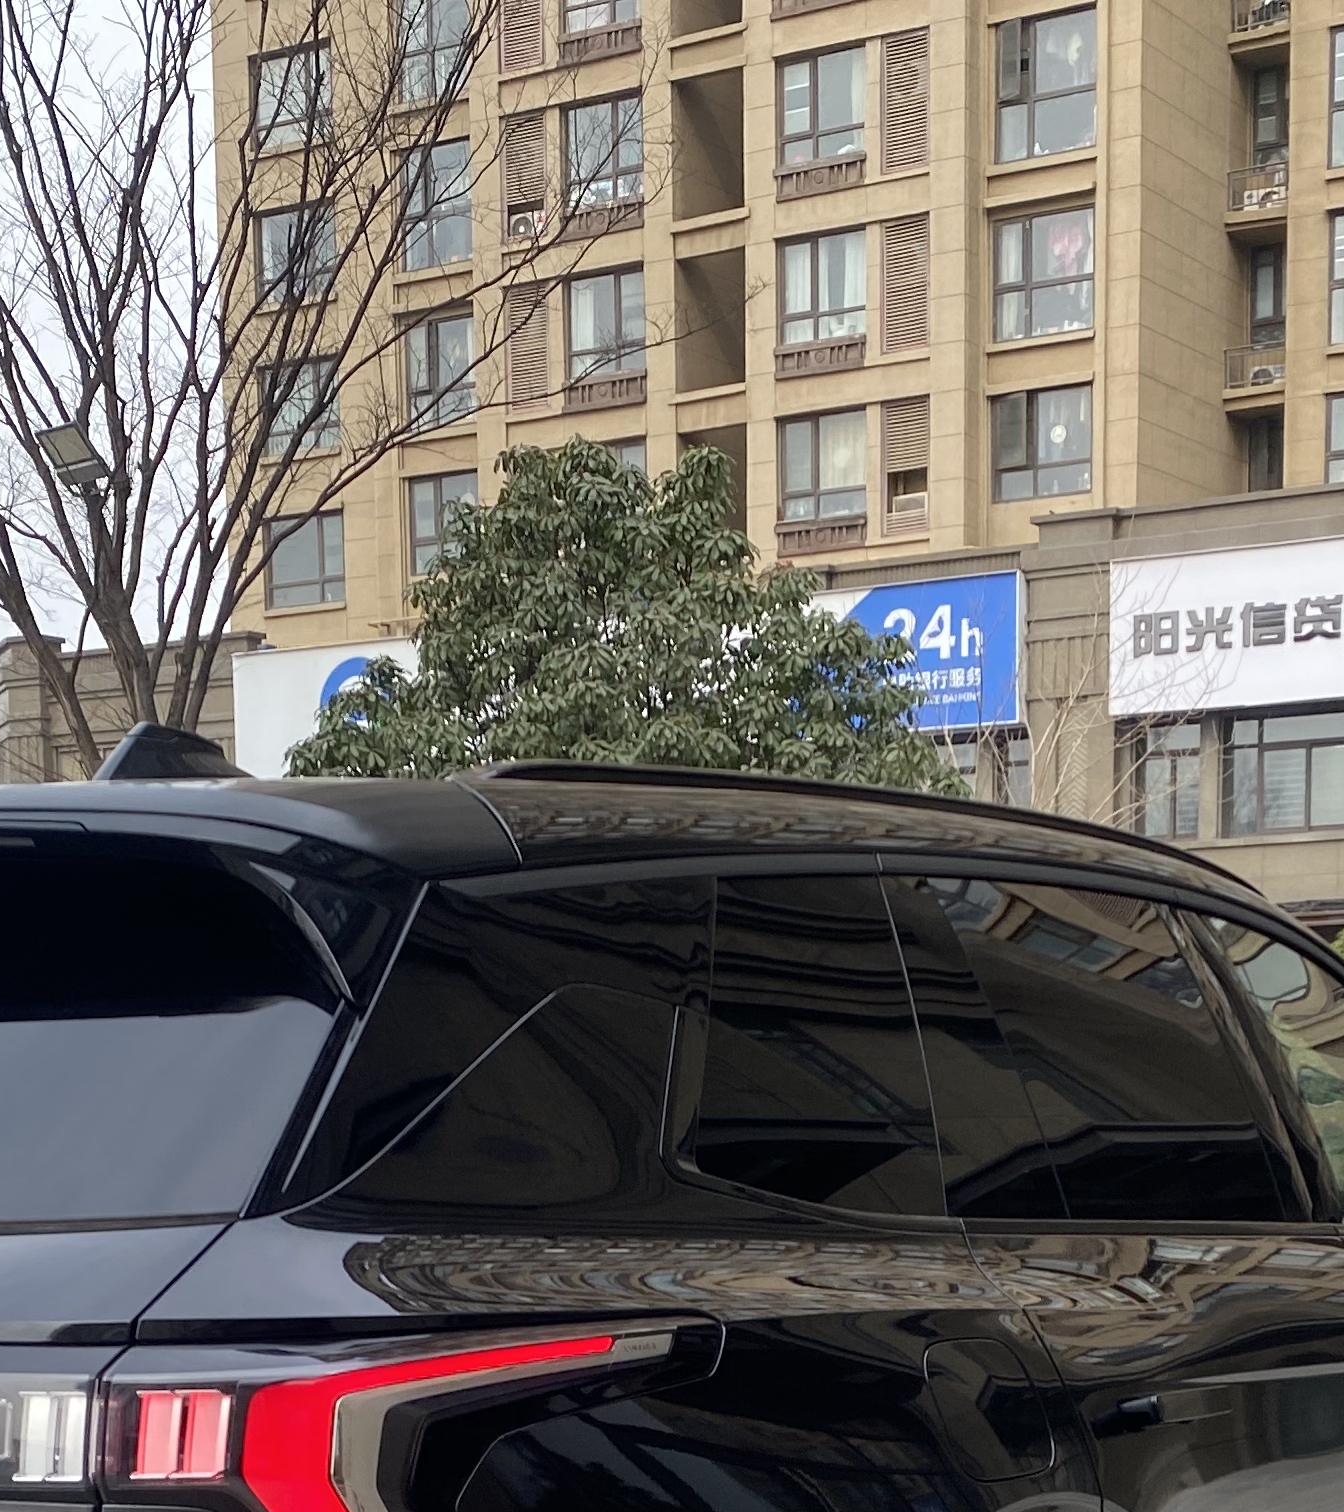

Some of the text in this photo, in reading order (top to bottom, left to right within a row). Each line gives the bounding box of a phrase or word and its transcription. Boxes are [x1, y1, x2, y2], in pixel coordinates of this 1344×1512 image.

[883, 604, 983, 664] 24h
[883, 666, 981, 691] 助银行服务
